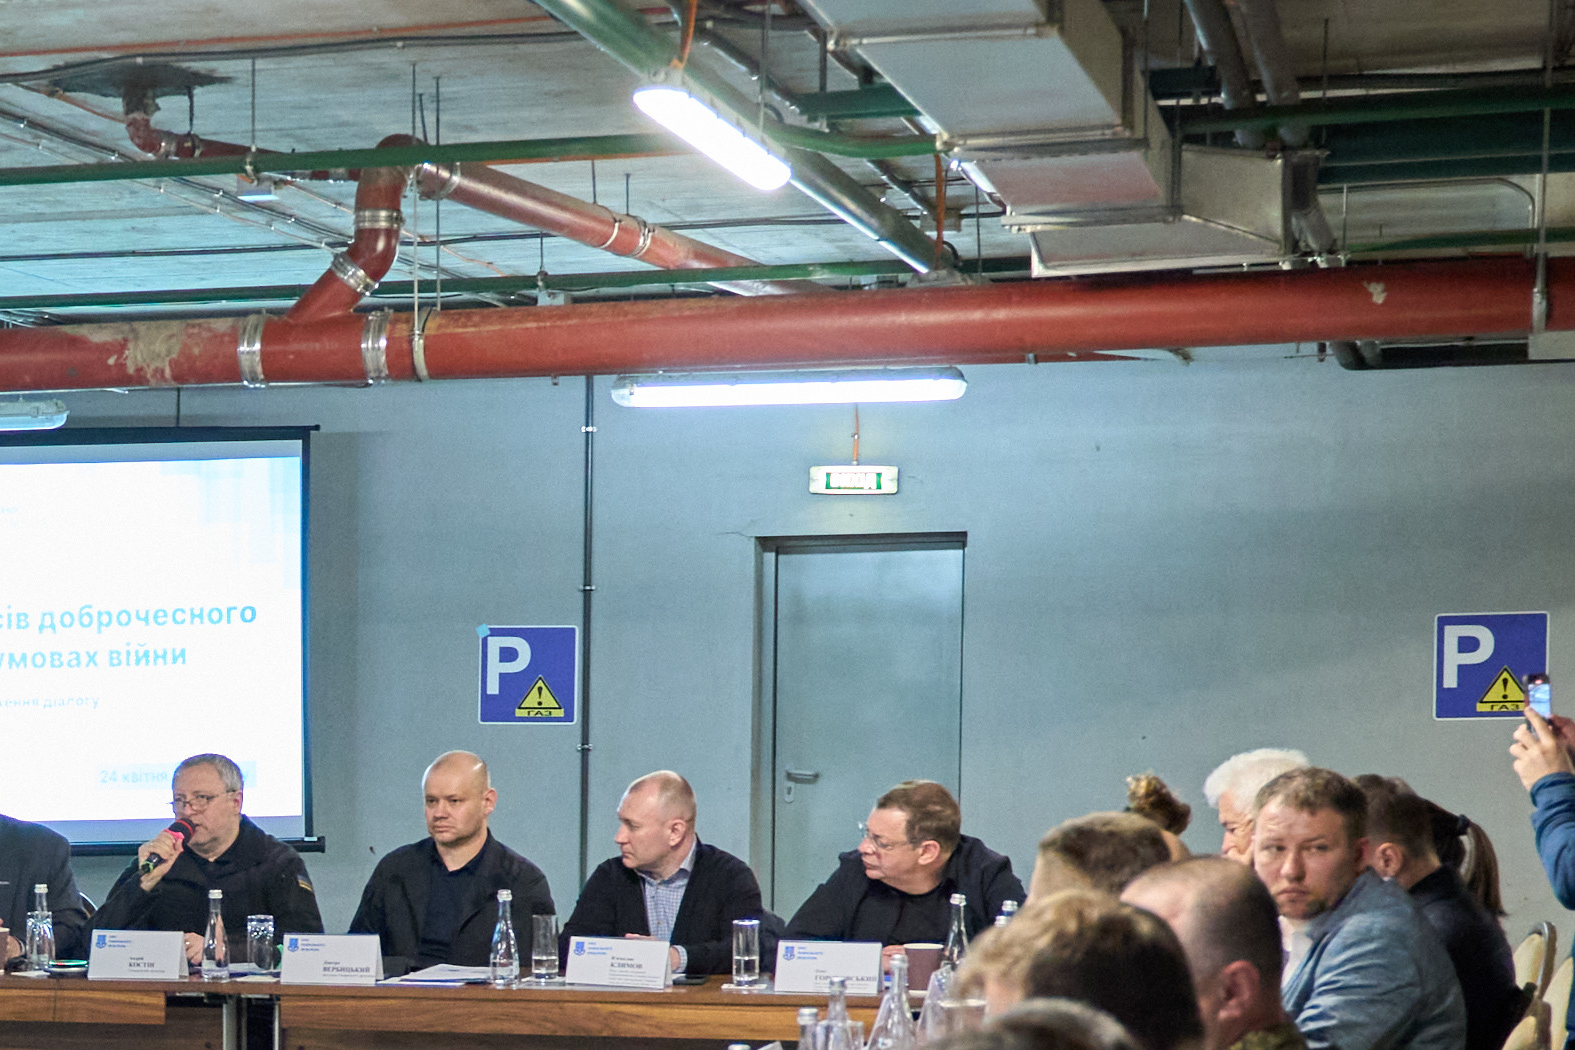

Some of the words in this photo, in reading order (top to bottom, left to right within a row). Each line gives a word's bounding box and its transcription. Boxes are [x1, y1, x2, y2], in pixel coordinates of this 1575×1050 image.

[38, 604, 257, 635] доброчесного
[108, 642, 187, 668] війни
[486, 636, 532, 695] P
[1443, 625, 1495, 689] P
[100, 770, 118, 784] 24
